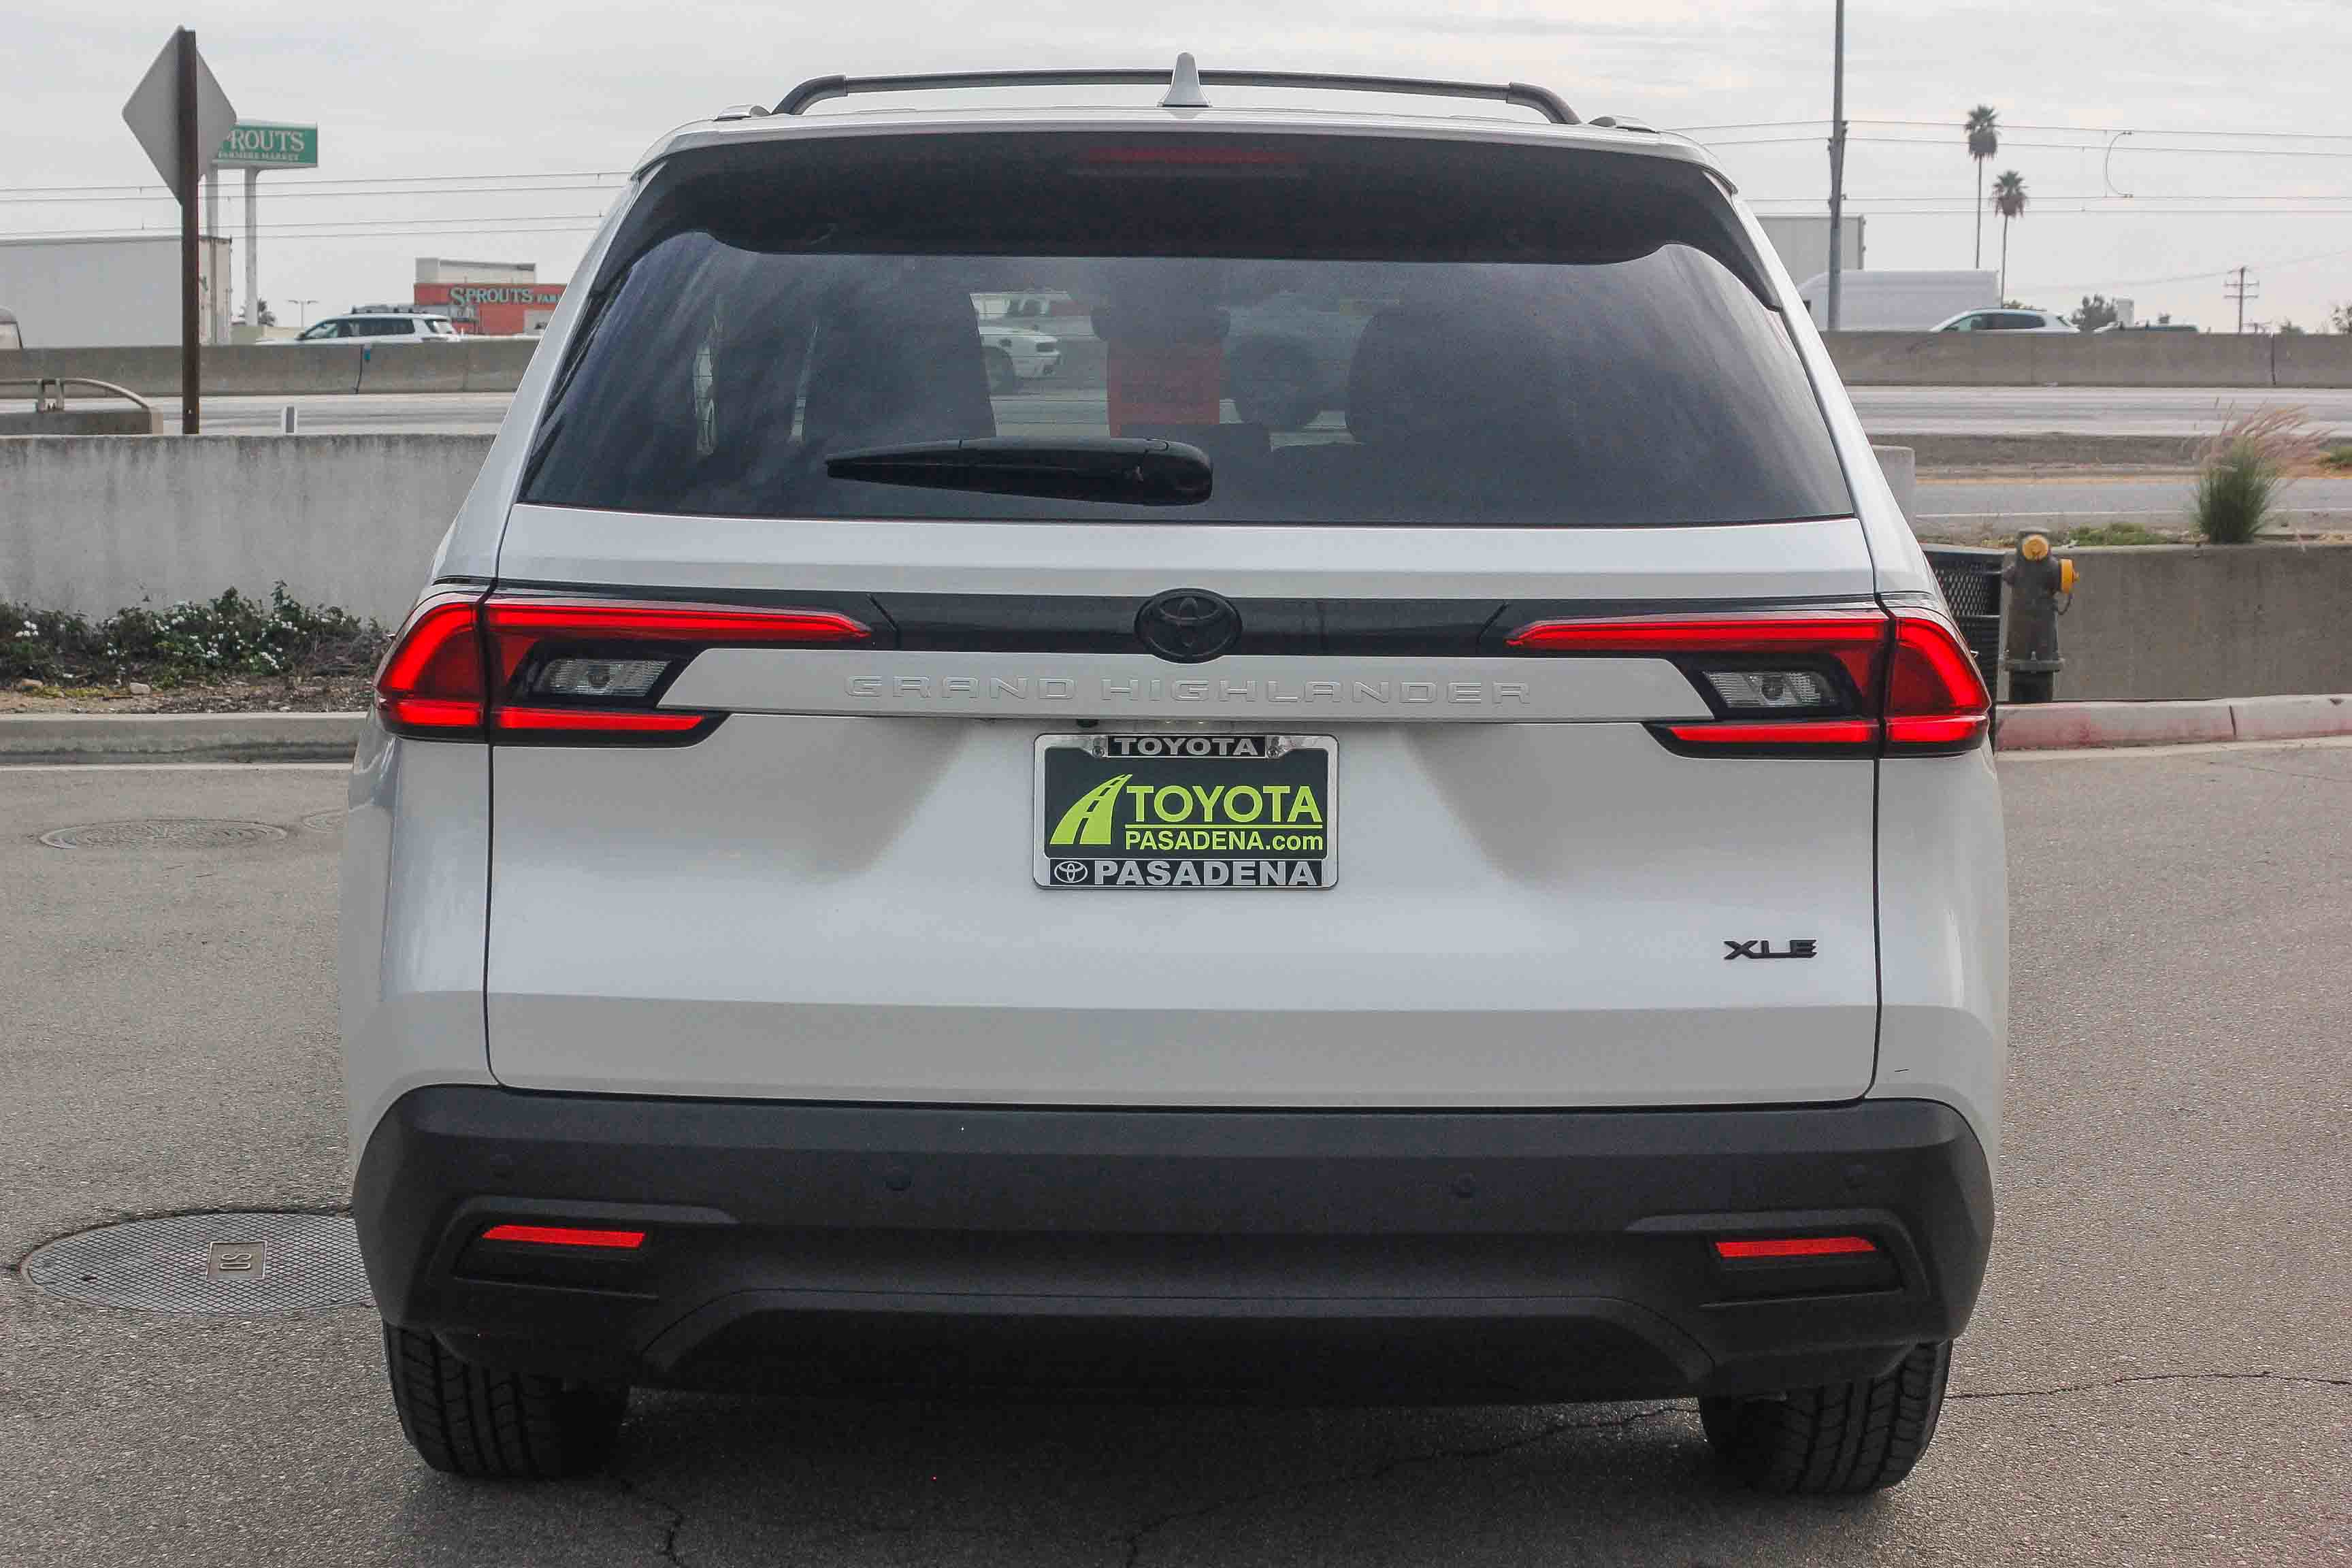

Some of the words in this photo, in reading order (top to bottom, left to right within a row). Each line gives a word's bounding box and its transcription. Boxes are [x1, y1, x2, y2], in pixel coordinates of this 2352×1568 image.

[228, 129, 305, 152] ROUTS
[450, 287, 534, 305] SPROUTS
[845, 675, 1077, 701] GRAND
[1101, 678, 1531, 705] HIGHLANDER
[1114, 737, 1258, 755] TOYOTA
[1126, 785, 1322, 823] TOYOTA
[1125, 830, 1323, 851] PASADENA.com
[1094, 860, 1318, 885] PASADENA
[1724, 940, 1818, 960] XLE
